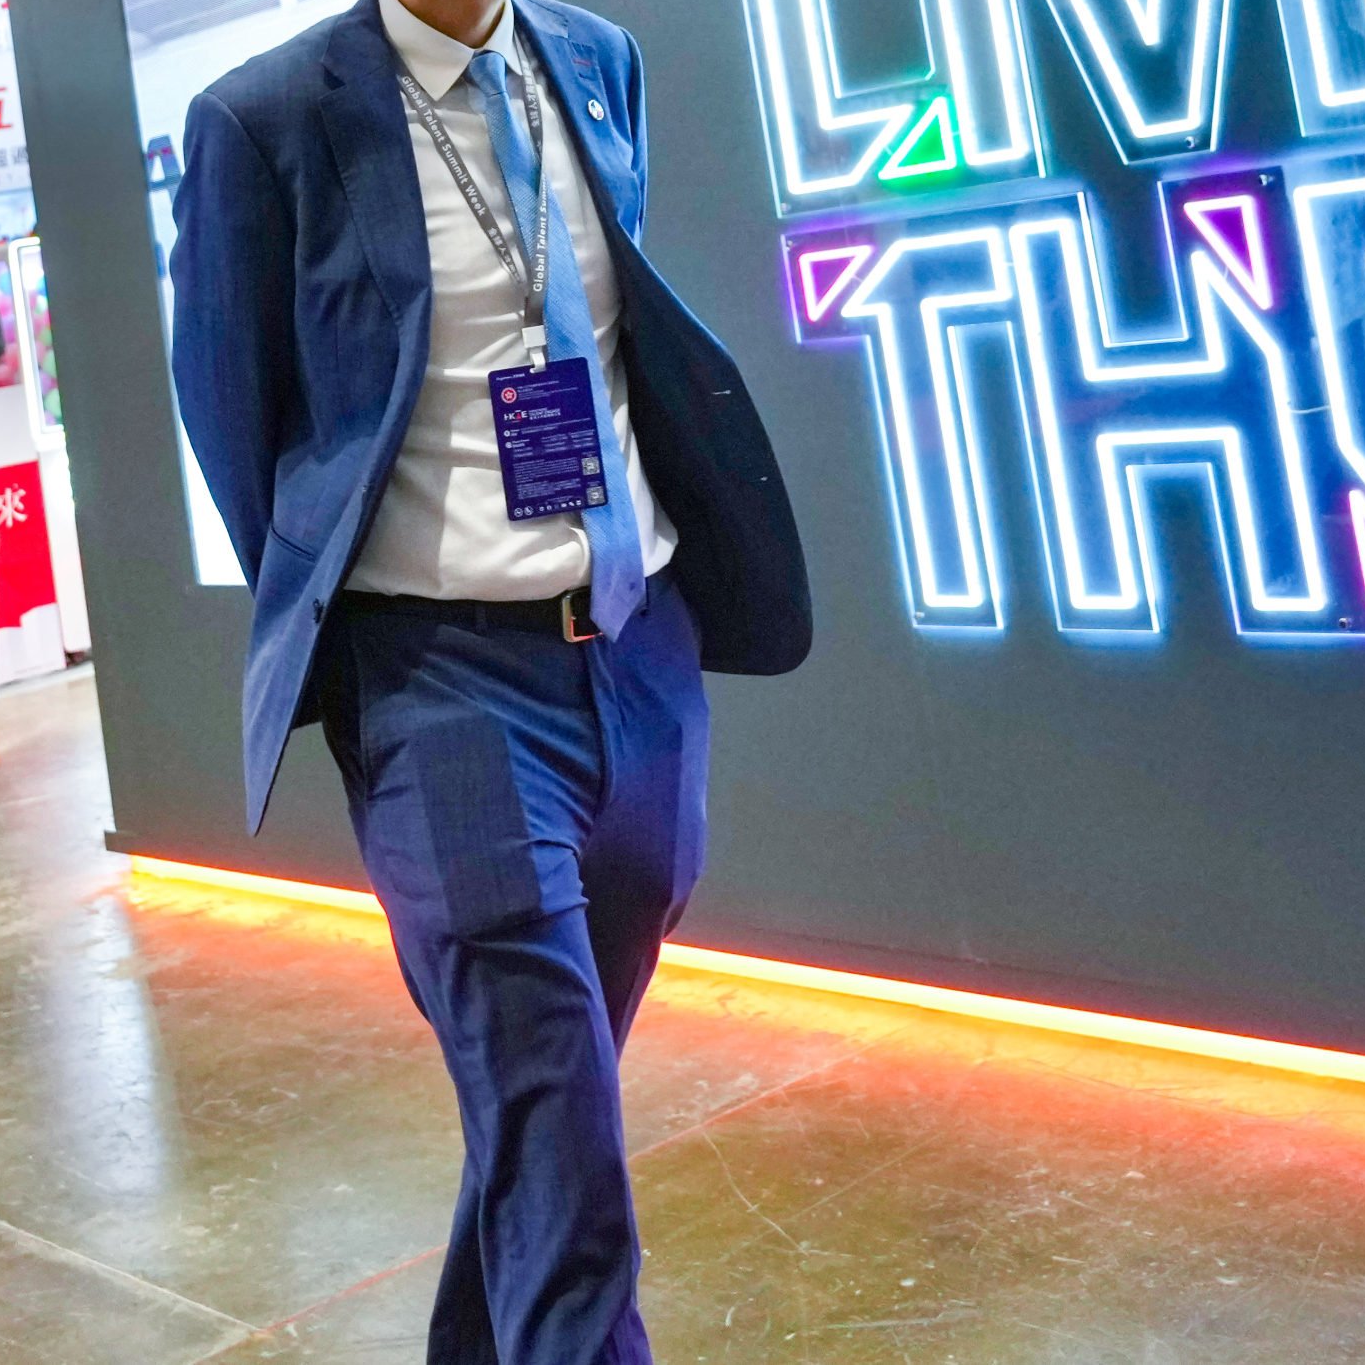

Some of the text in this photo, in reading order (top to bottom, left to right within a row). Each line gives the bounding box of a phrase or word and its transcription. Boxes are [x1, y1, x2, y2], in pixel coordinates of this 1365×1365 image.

[402, 75, 486, 216] Global Talent Summit Week
[537, 217, 547, 250] Talent
[533, 253, 546, 292] Global
